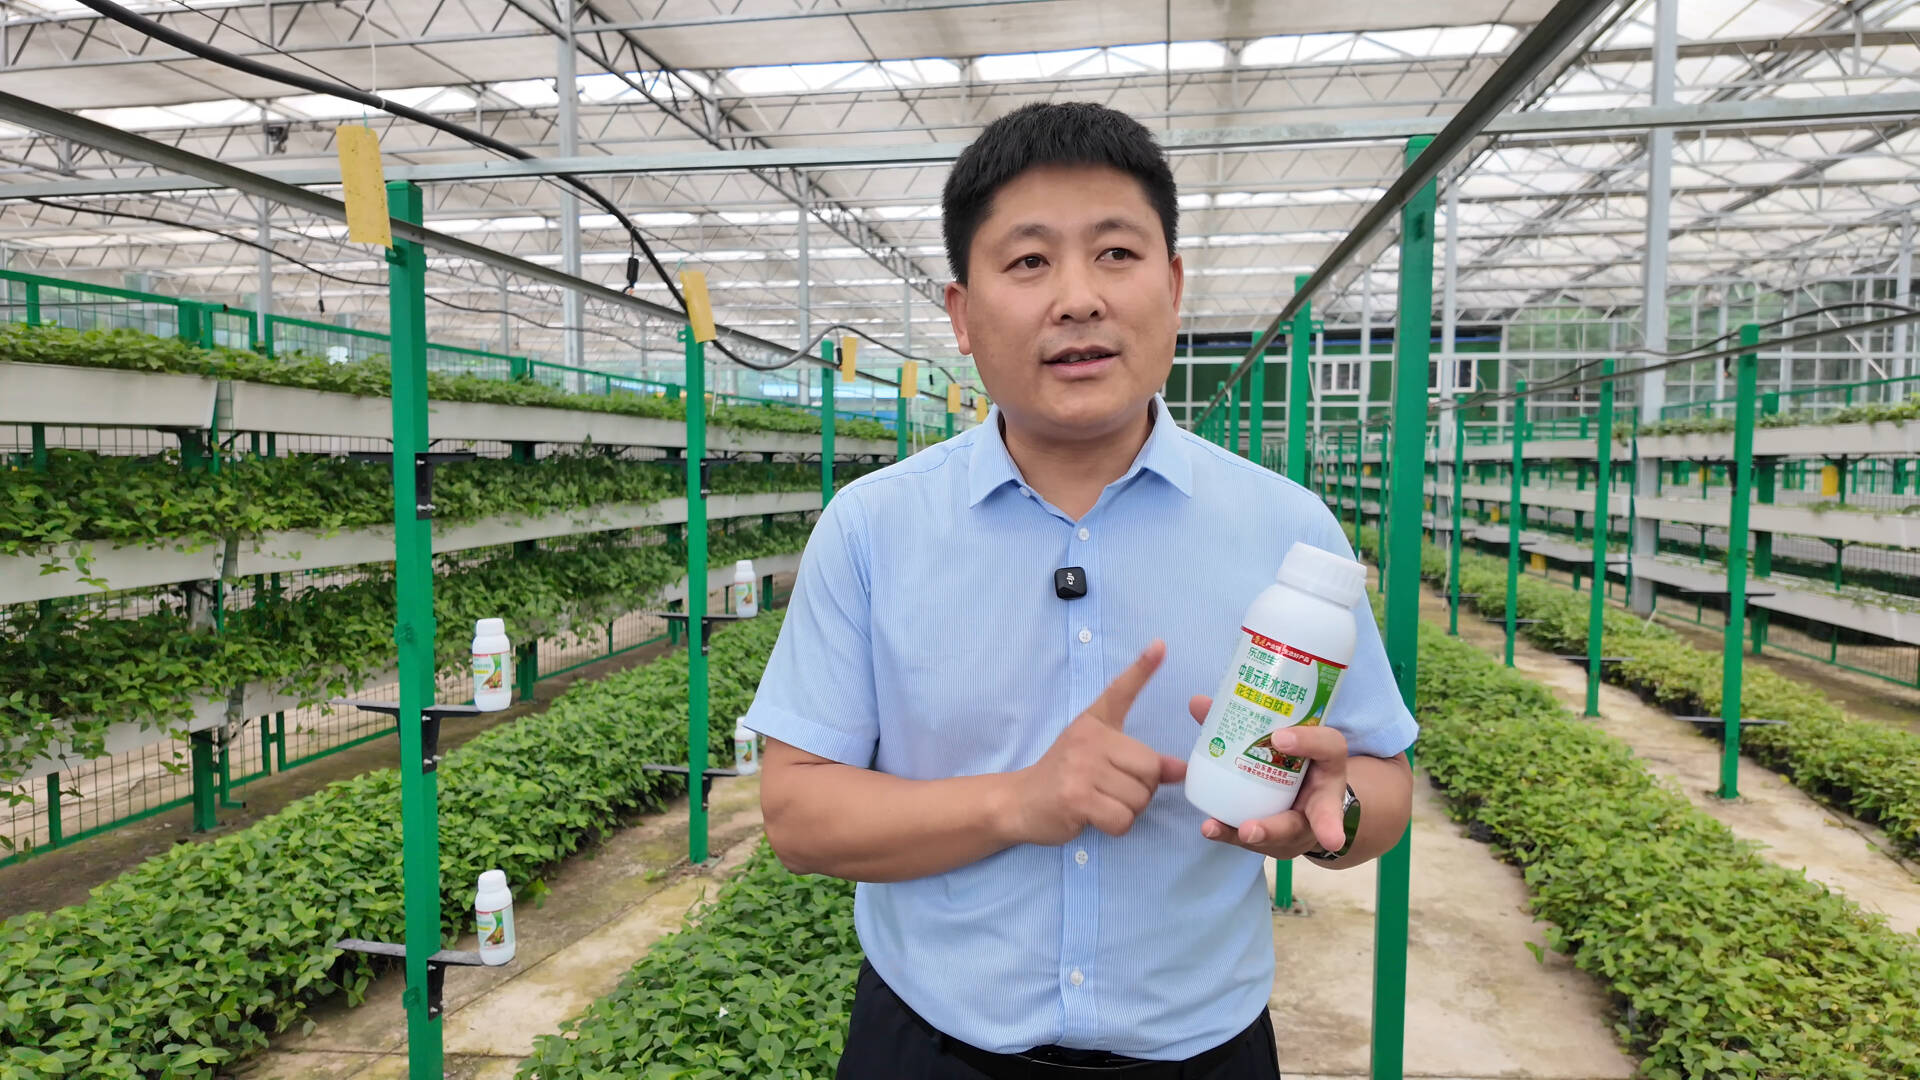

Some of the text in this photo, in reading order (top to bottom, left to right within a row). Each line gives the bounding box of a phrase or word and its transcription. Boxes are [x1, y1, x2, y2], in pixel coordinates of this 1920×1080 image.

[1238, 664, 1308, 704] 中量元素水溶肥料
